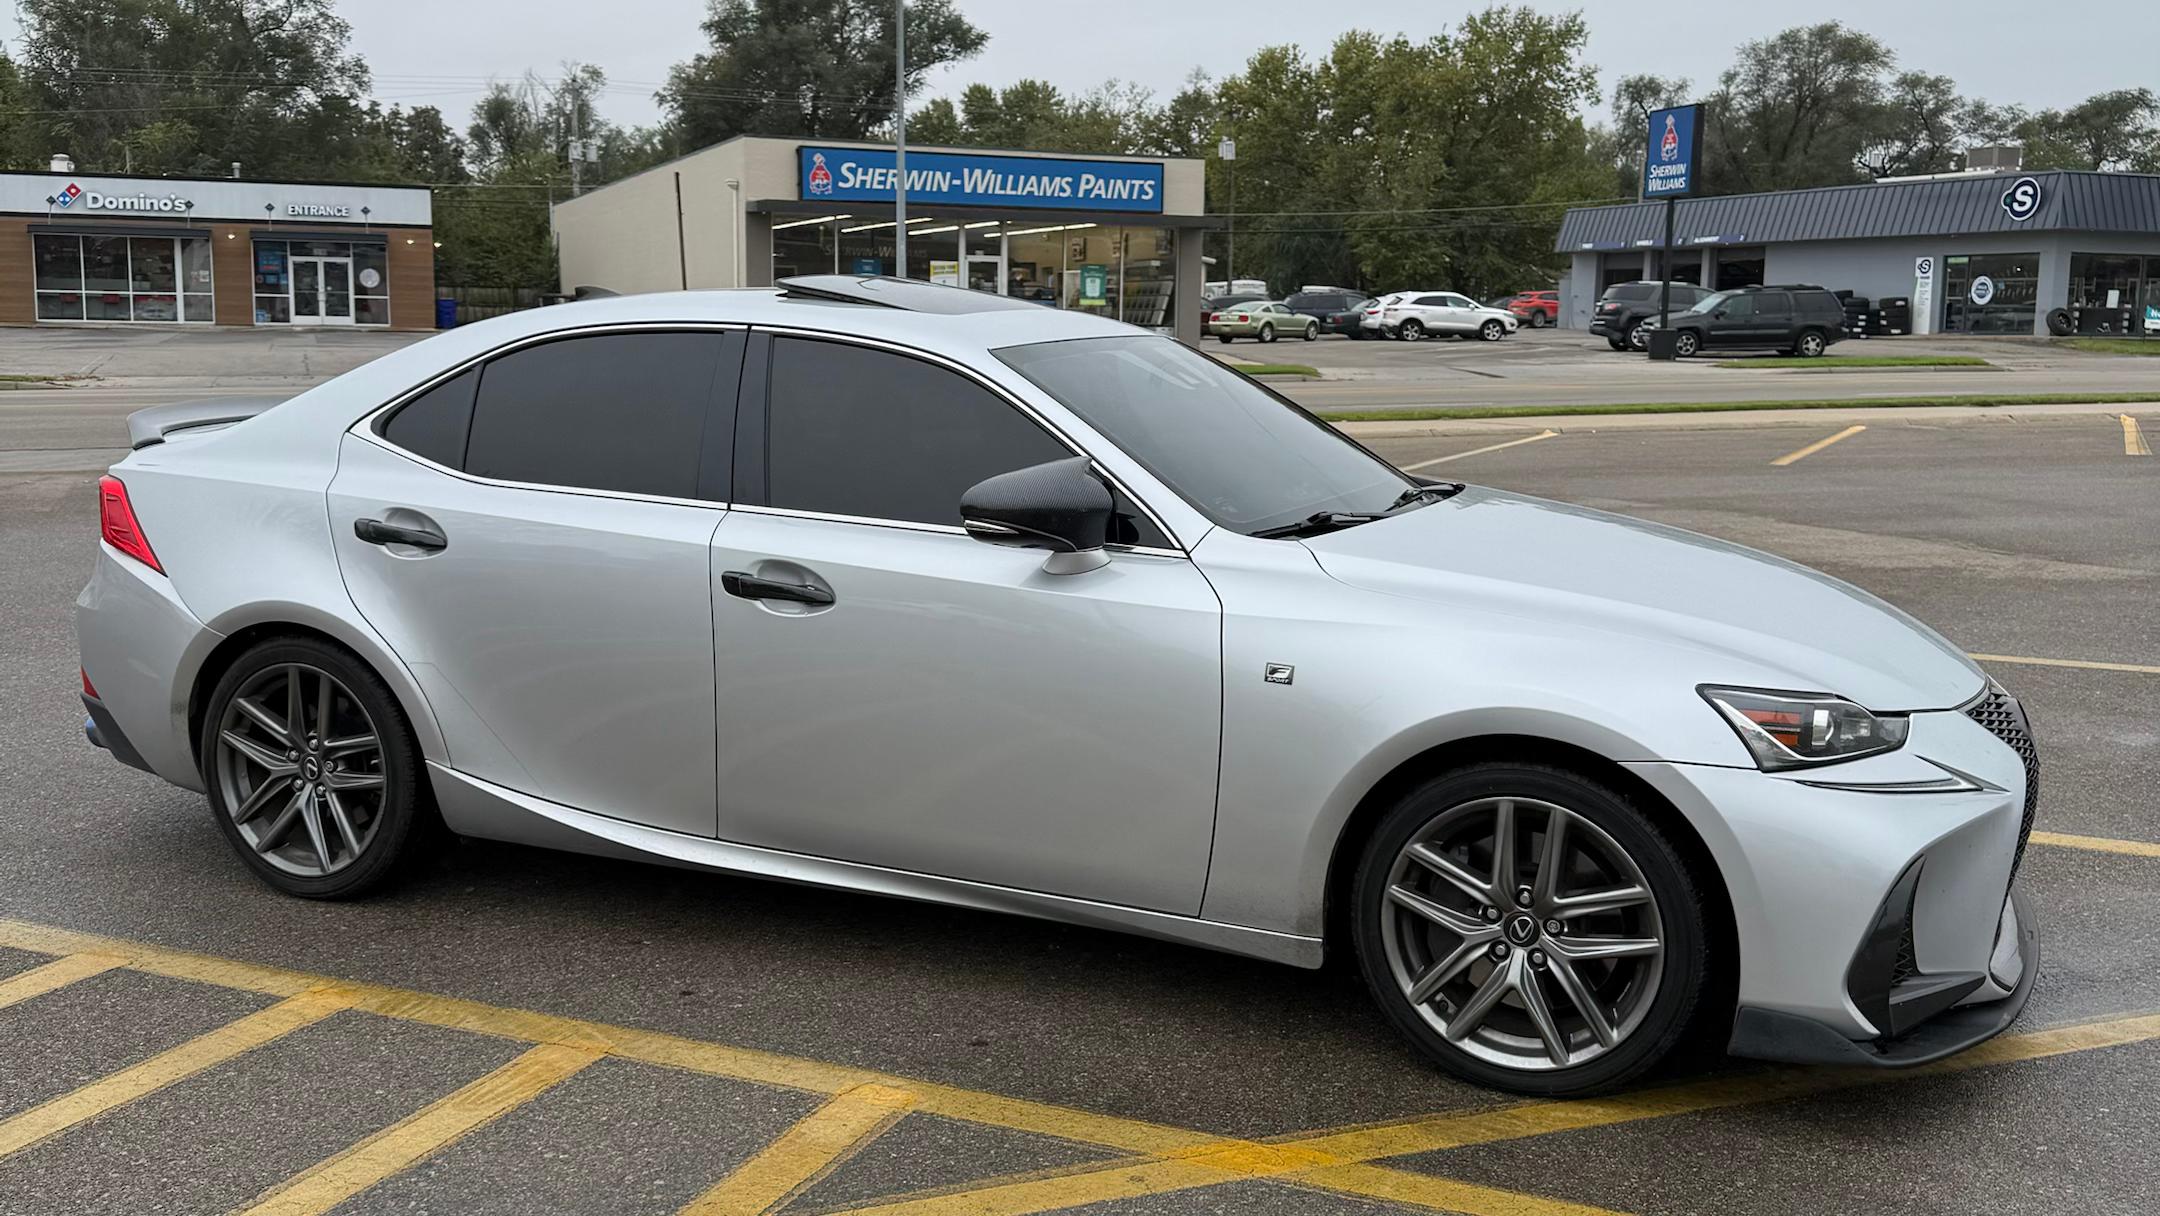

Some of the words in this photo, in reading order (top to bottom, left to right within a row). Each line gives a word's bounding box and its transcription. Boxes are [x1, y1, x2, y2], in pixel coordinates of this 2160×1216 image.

[1649, 163, 1687, 178] SHERWIN
[838, 161, 1073, 197] SHERWIN-WILLIAMS
[1077, 173, 1155, 200] PAINTS
[1648, 176, 1686, 192] WILLIAMS
[86, 191, 187, 212] Domino's
[287, 204, 349, 217] ENTRANCE
